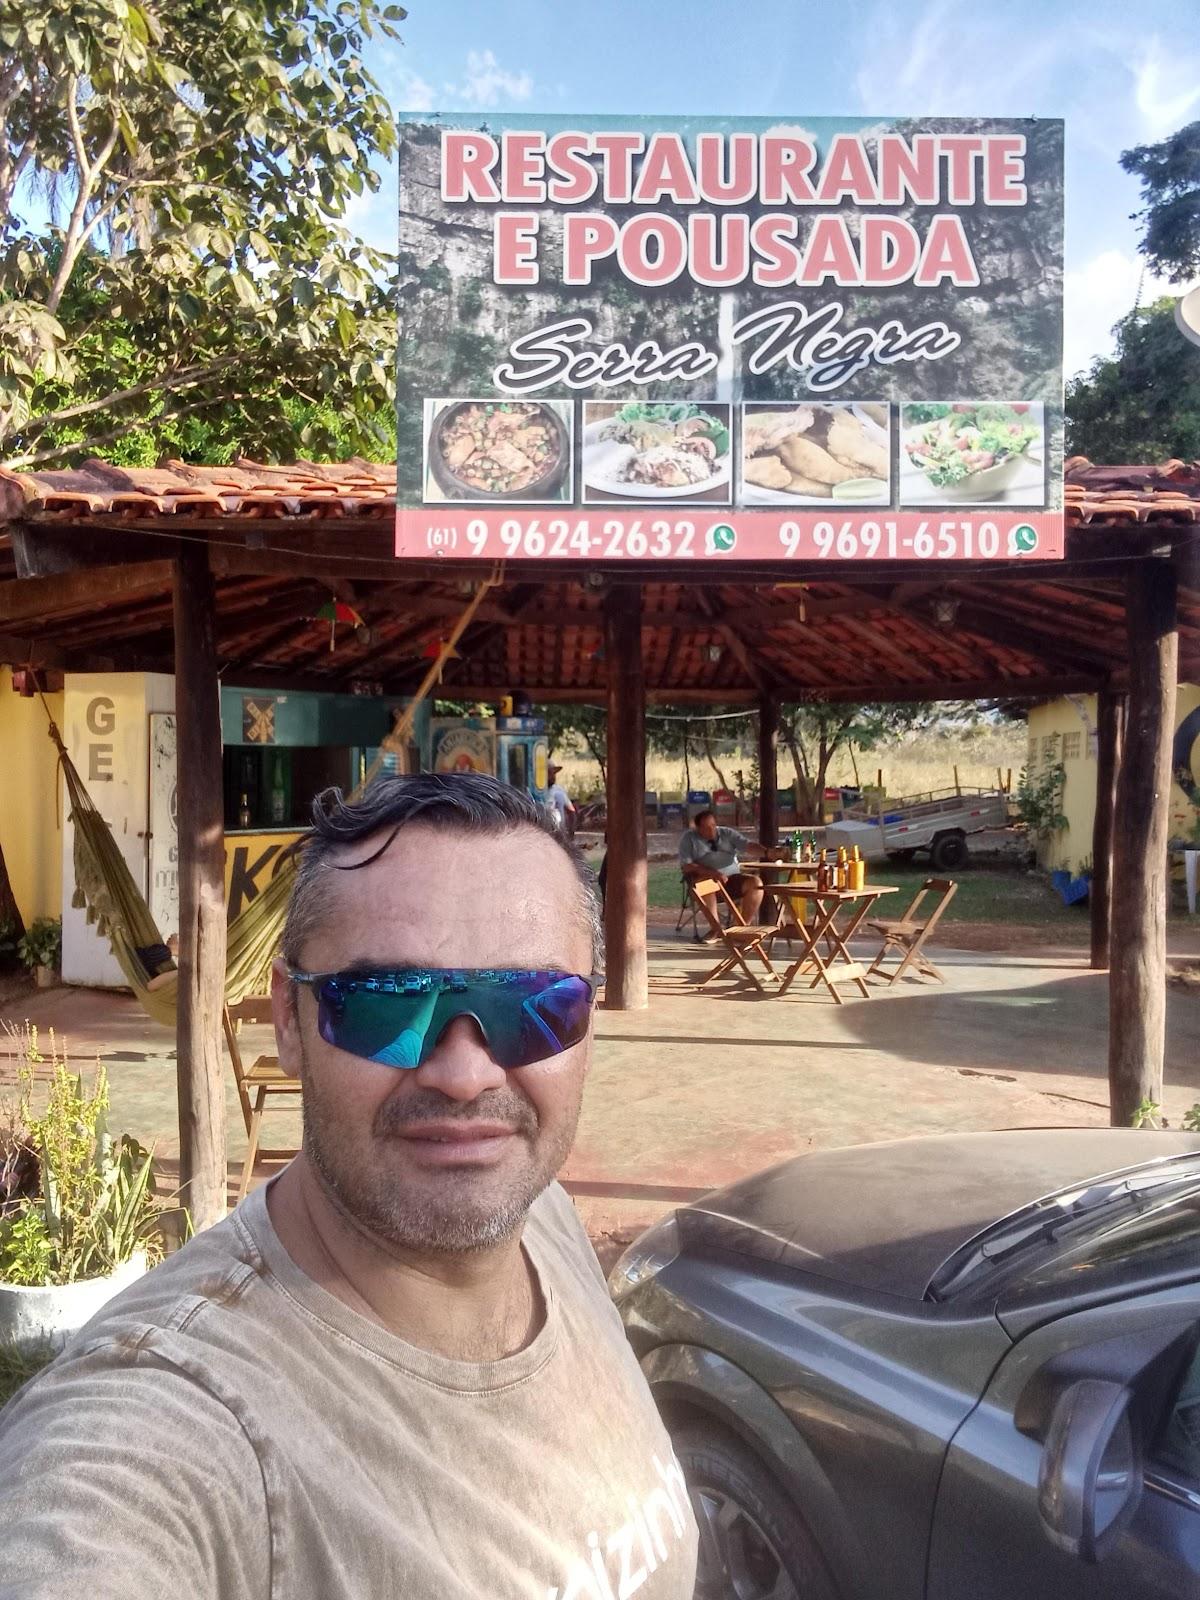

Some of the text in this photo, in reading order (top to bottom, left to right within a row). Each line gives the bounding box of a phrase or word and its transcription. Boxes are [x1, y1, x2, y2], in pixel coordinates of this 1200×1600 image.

[441, 130, 1028, 206] RESTAURANTE
[494, 211, 981, 288] E POUSADA
[493, 300, 961, 394] Serra Negra
[426, 519, 695, 558] (61) 9 9624-2632
[779, 521, 999, 559] 9 9691-6510
